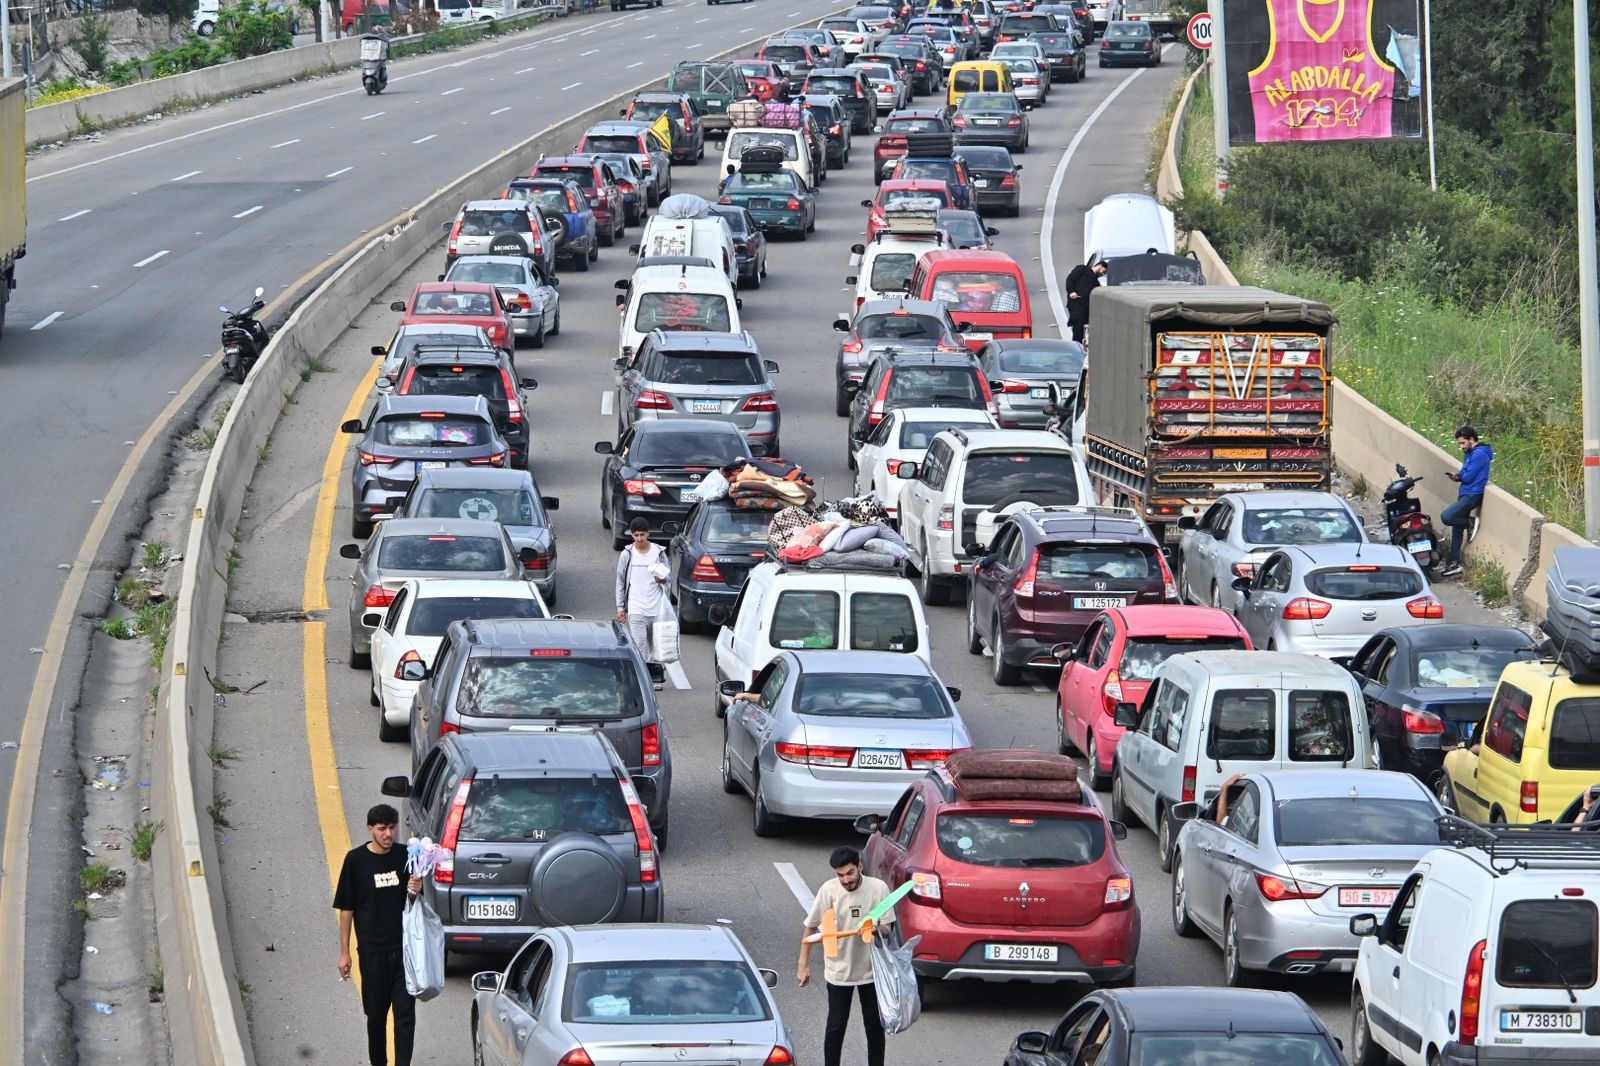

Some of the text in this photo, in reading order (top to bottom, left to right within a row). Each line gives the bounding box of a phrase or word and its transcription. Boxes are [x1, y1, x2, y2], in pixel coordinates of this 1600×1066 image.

[1264, 66, 1381, 107] ALABDALLA
[1080, 599, 1121, 608] N 125172
[1345, 892, 1358, 903] 50
[1374, 892, 1397, 903] 571
[994, 946, 1050, 959] B 299148
[1511, 1014, 1573, 1027] M 738310
